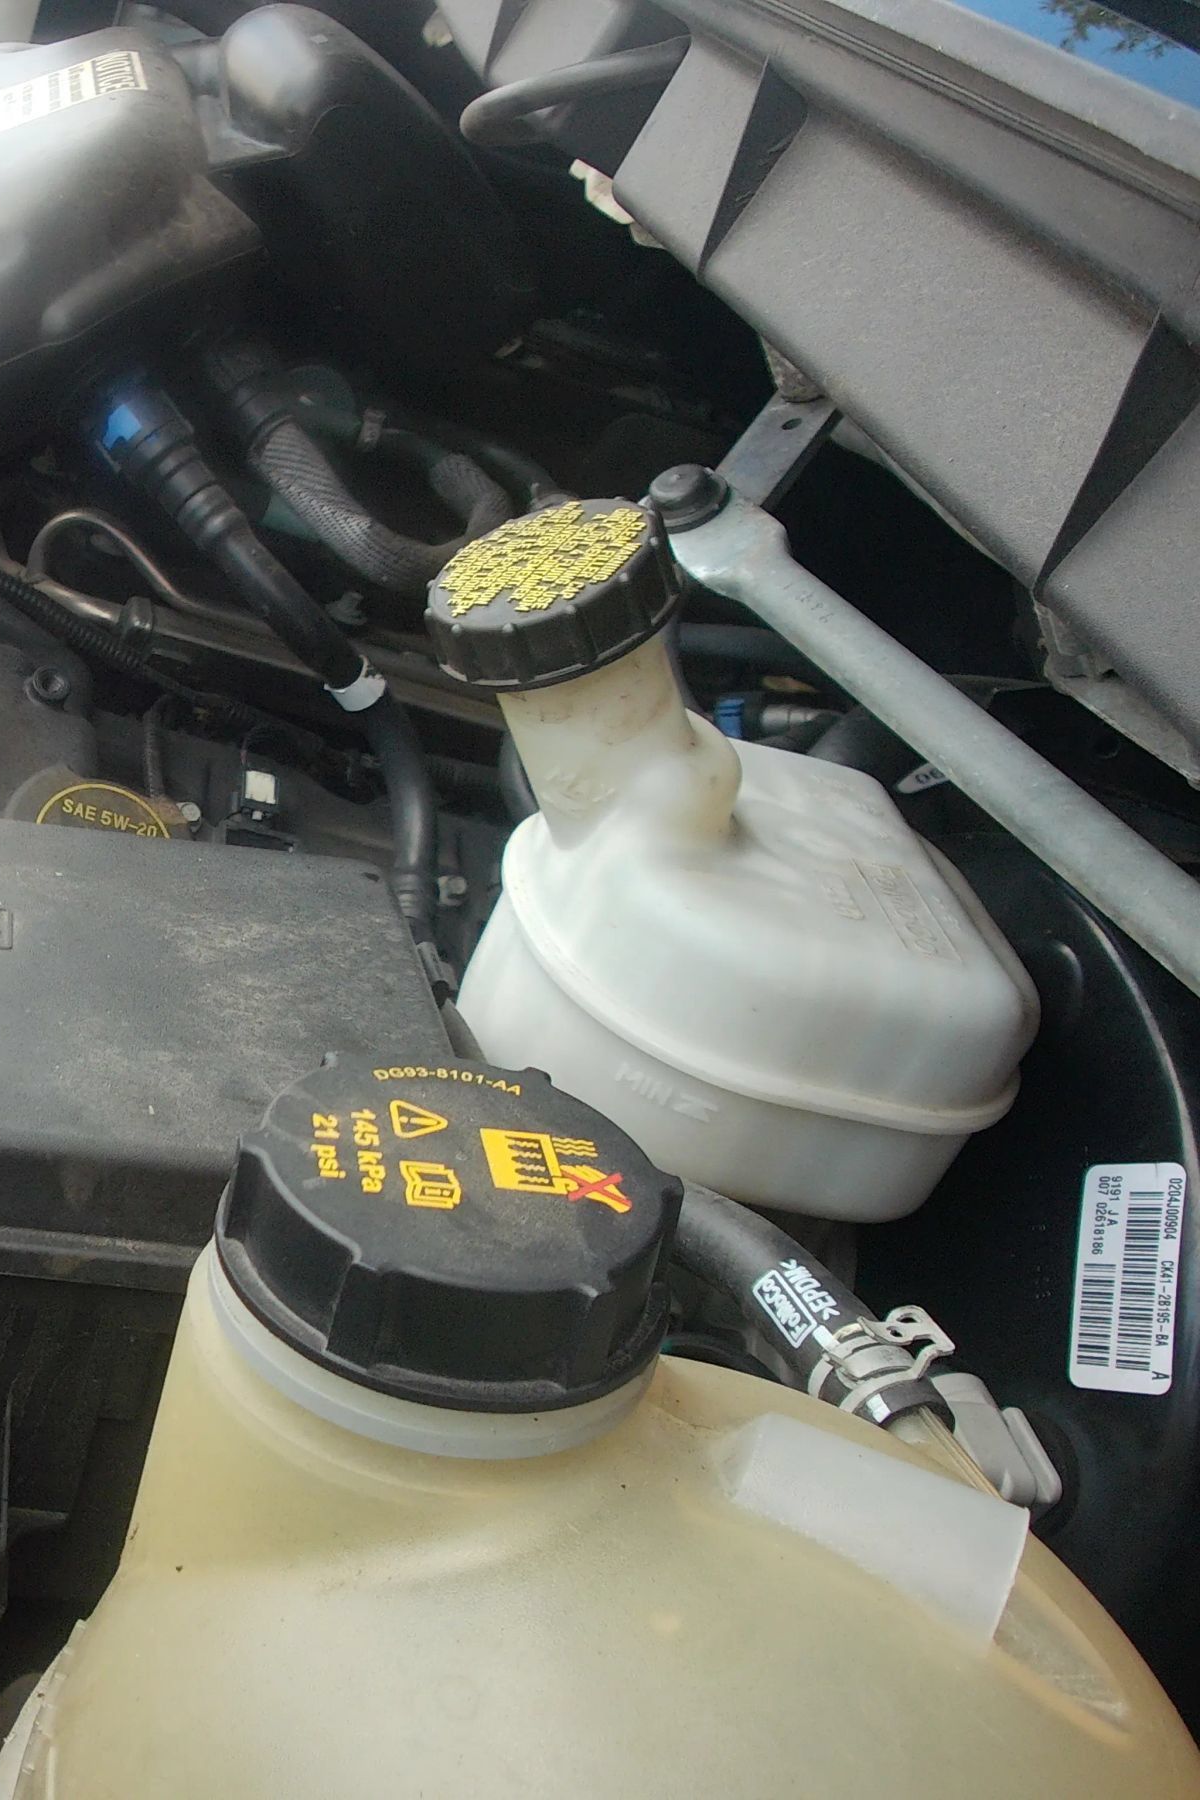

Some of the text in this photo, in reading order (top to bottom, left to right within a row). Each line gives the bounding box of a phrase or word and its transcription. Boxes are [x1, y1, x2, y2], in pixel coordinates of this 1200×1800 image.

[96, 52, 137, 92] NOTICE
[506, 519, 531, 533] DOT
[528, 525, 552, 536] DE
[530, 508, 586, 546] NETTOYER
[598, 507, 632, 528] ONLY
[598, 511, 643, 540] BEFORE
[495, 538, 524, 555] QUE
[556, 521, 599, 551] SEALED
[576, 530, 607, 546] DOT
[446, 545, 503, 590] PROVENANT
[480, 557, 505, 569] DU
[539, 558, 577, 581] FLUID
[556, 522, 647, 599] CLEAN FILLER CAP
[472, 565, 523, 604] BOUCHON
[511, 585, 549, 611] FROM
[527, 591, 560, 609] USE
[62, 798, 158, 837] SAE 5W-20
[373, 1066, 521, 1096] DG93-8101-AA
[615, 1061, 673, 1107] MIN
[310, 1112, 346, 1179] 21 psi
[351, 1108, 386, 1193] 145 kPa
[1109, 1175, 1123, 1201] 9191
[1091, 1176, 1111, 1255] 007 02618186
[1151, 1177, 1183, 1381] 0204J00904 CK41-2B195-BA A
[762, 1279, 808, 1341] FoMoCo
